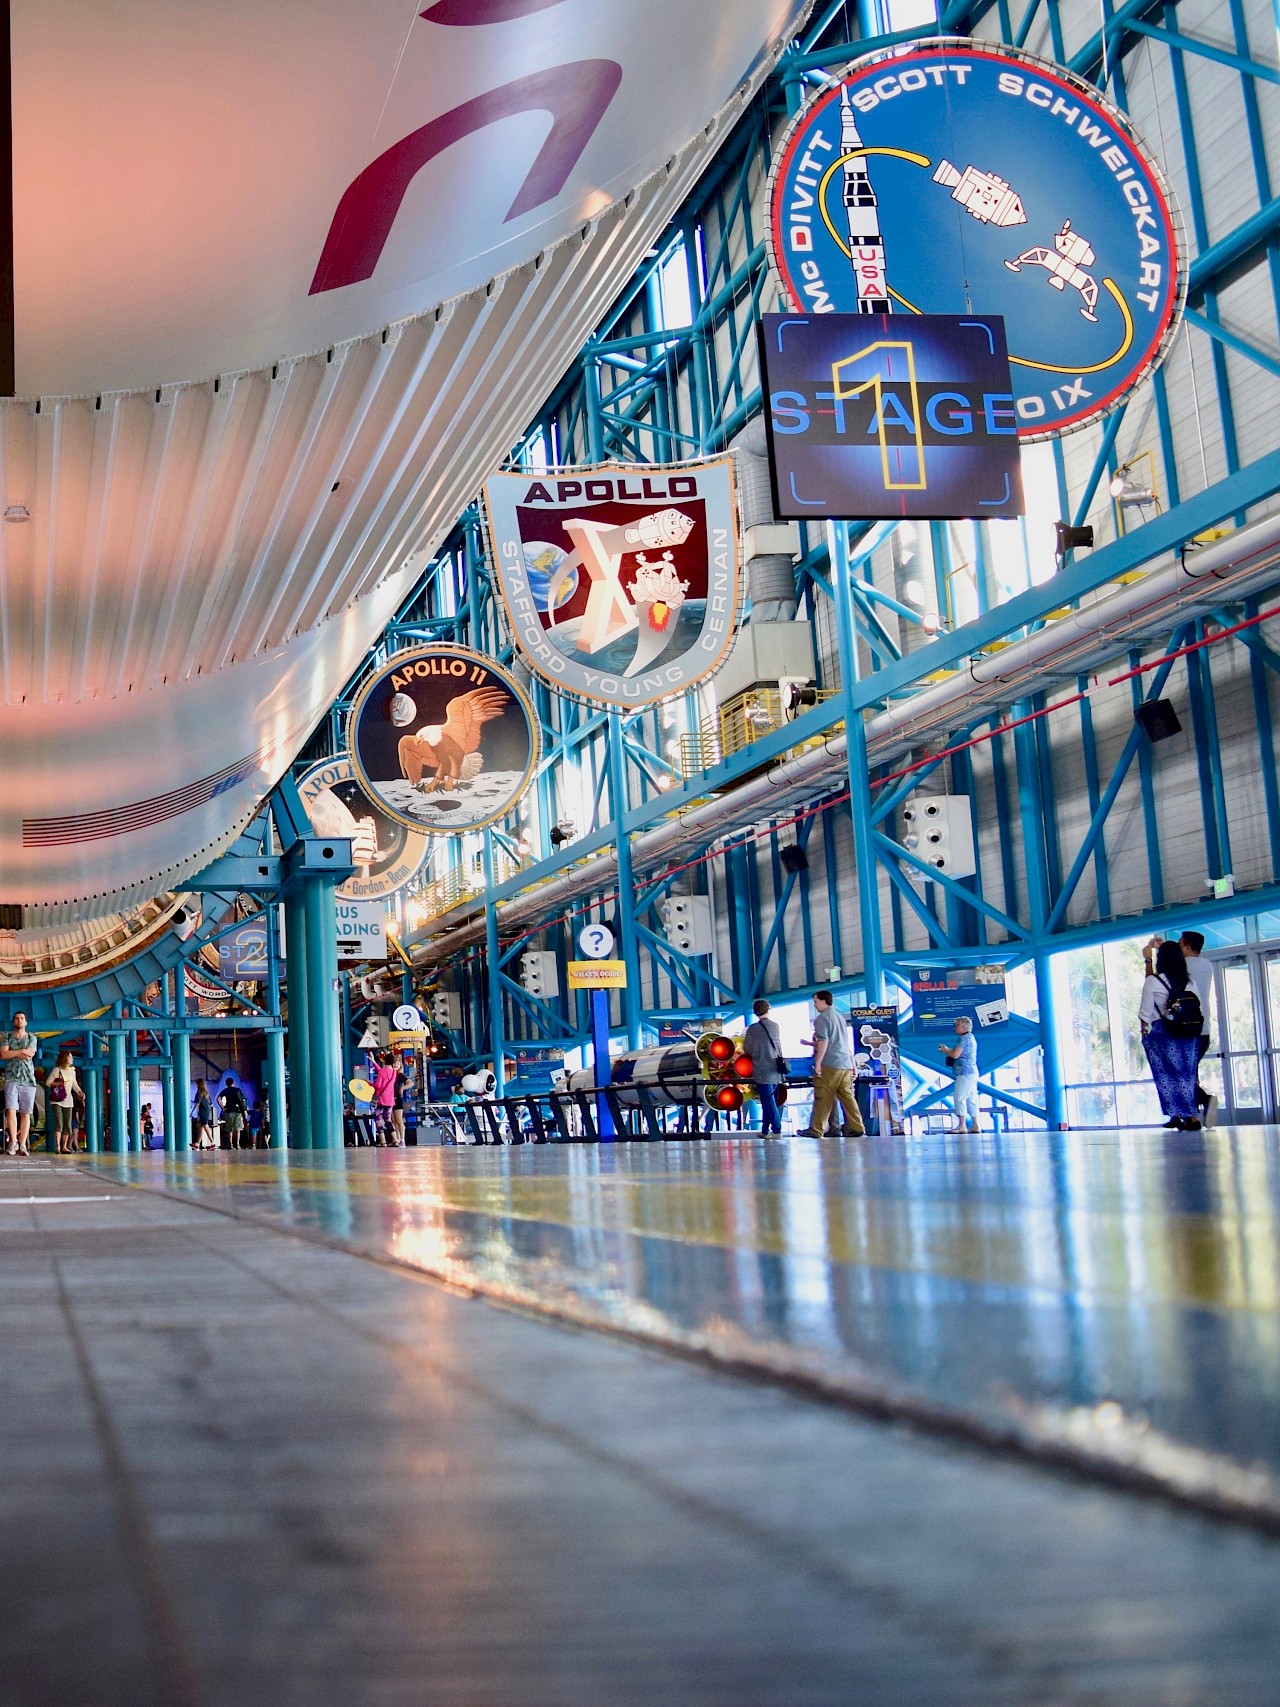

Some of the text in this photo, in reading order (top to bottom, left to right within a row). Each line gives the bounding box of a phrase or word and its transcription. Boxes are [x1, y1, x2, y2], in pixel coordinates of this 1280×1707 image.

[790, 130, 833, 251] DIVITT
[852, 64, 972, 113] SCOTT
[998, 72, 1160, 313] SCHWEICKART
[858, 249, 883, 297] USA
[1051, 377, 1093, 411] IX
[772, 390, 1017, 435] STAGE
[832, 341, 927, 490] 1
[523, 476, 697, 503] APOLLO
[502, 528, 728, 698] STAFFORD YOUNG CERNAN
[390, 659, 488, 692] APOLLO 11
[352, 879, 385, 895] Gordon
[387, 864, 410, 884] Bean
[220, 945, 267, 958] STA
[236, 929, 268, 973] 2
[202, 988, 231, 998] WORD
[852, 1008, 895, 1017] COSMIC QUEST
